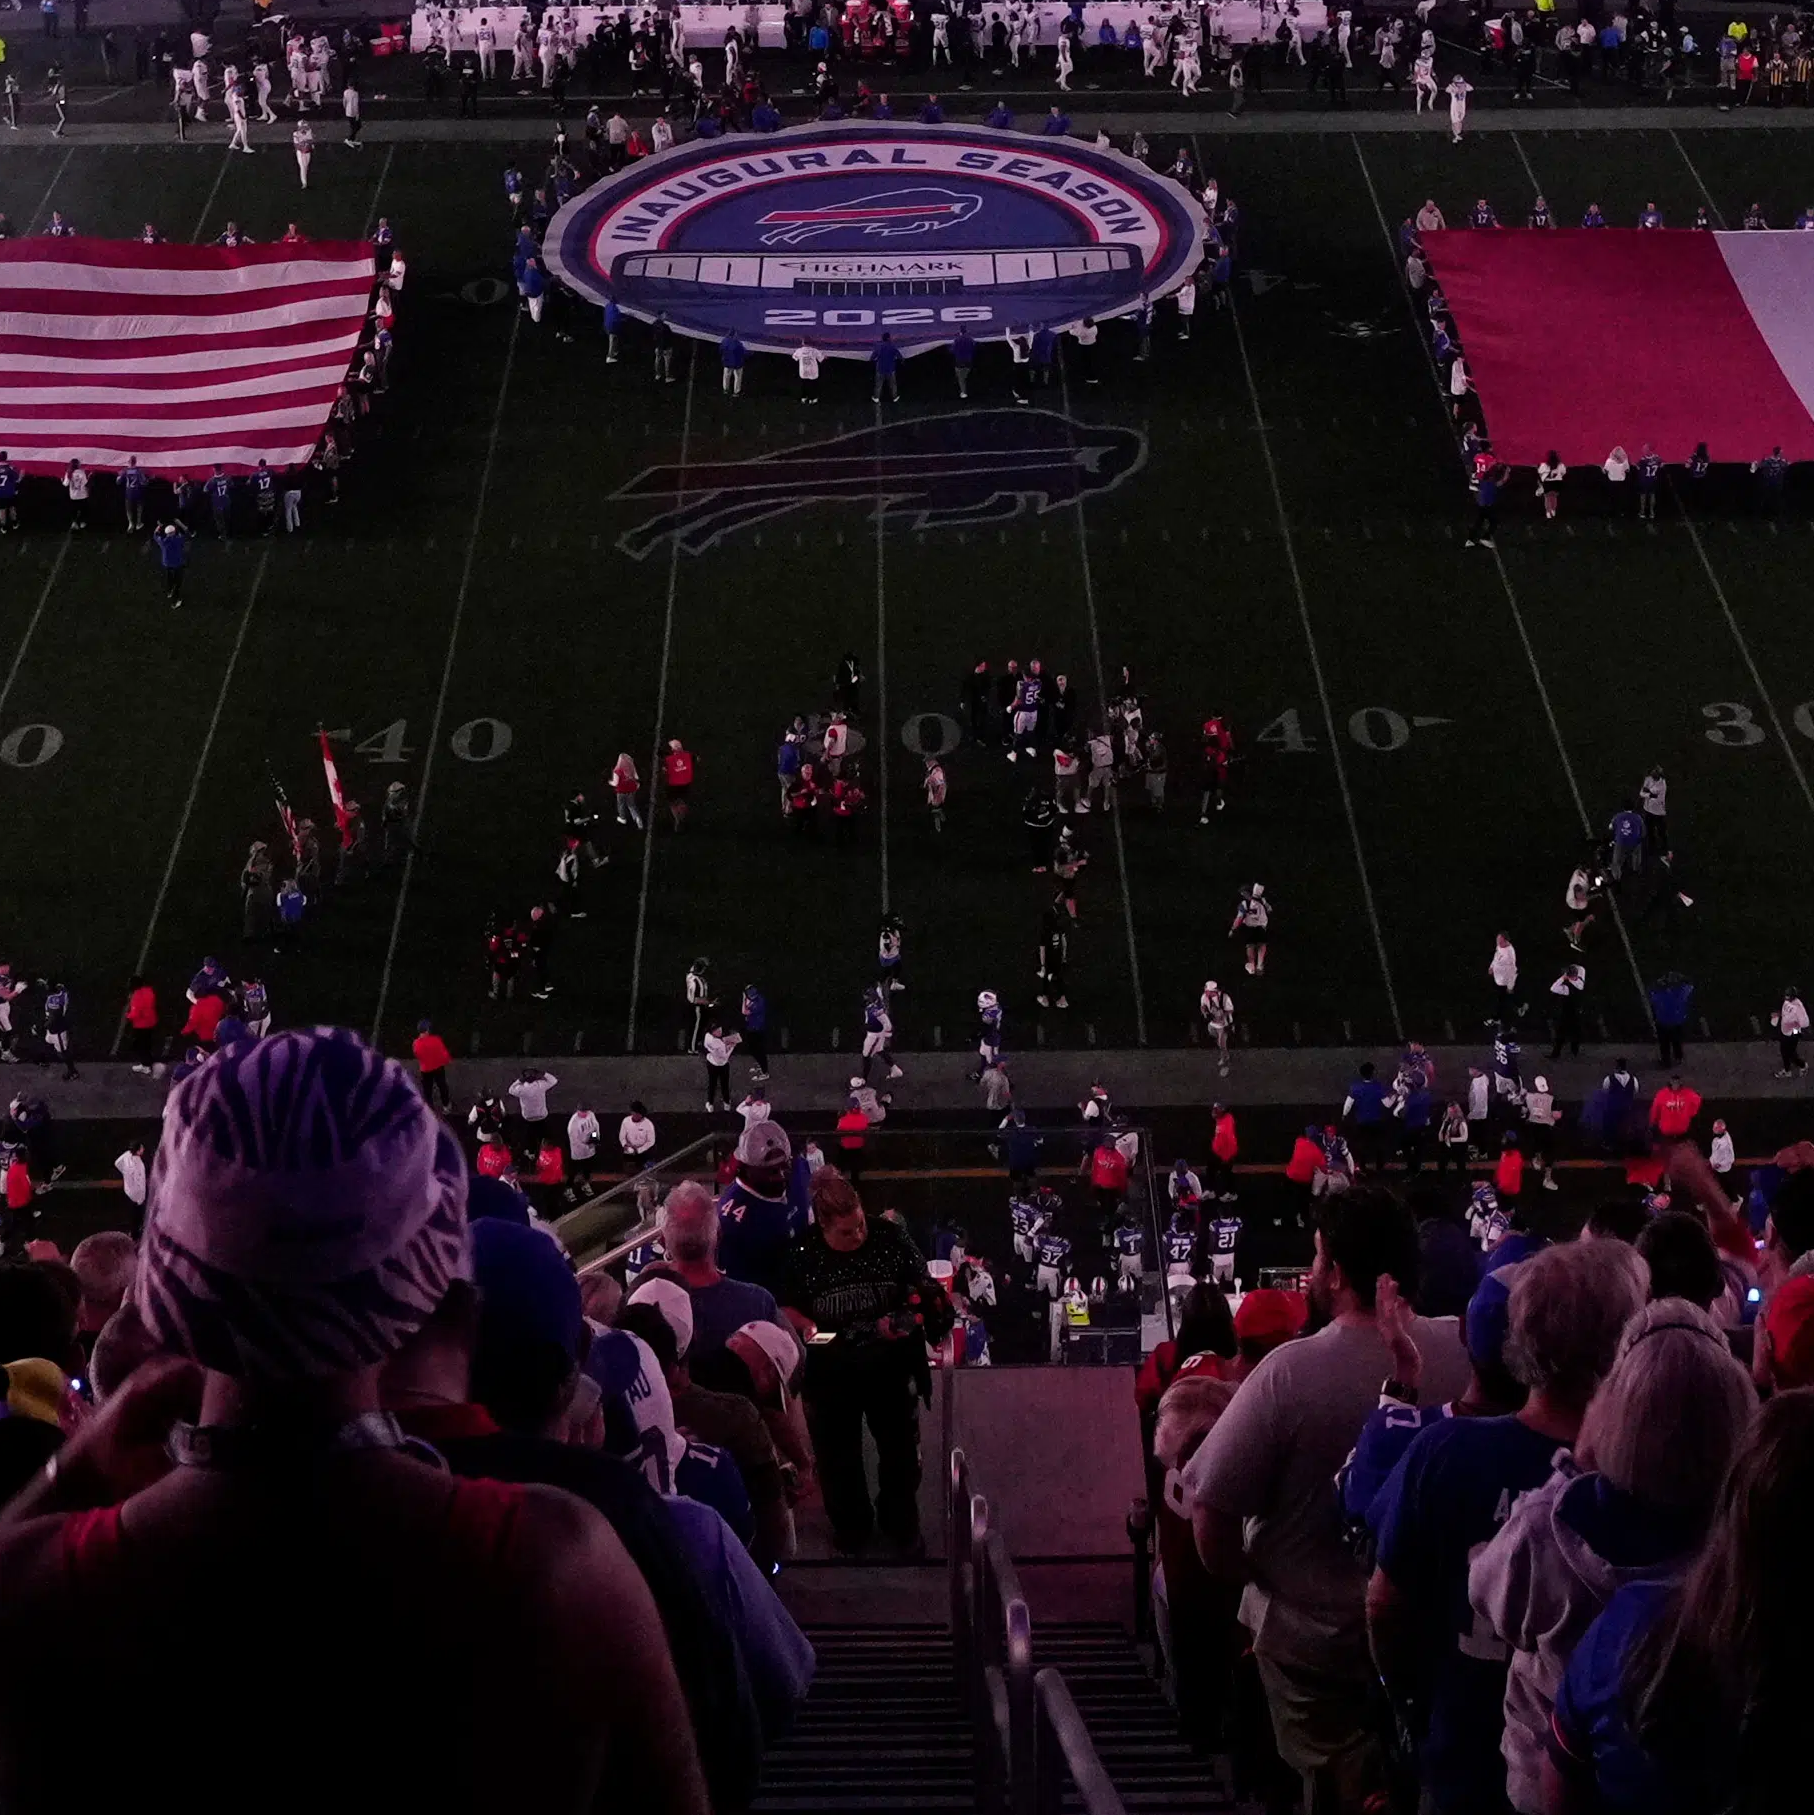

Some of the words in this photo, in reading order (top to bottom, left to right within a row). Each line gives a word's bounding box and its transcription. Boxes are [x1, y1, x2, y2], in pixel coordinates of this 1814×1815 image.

[611, 147, 927, 243] INAUGURAL
[955, 152, 1146, 237] SEASON
[796, 260, 966, 274] HIGHMARK
[763, 305, 994, 327] 2026
[1253, 703, 1411, 754] 40
[353, 716, 515, 764] 40
[720, 1201, 747, 1223] 44
[1041, 1249, 1063, 1265] 37
[1169, 1244, 1192, 1261] 47
